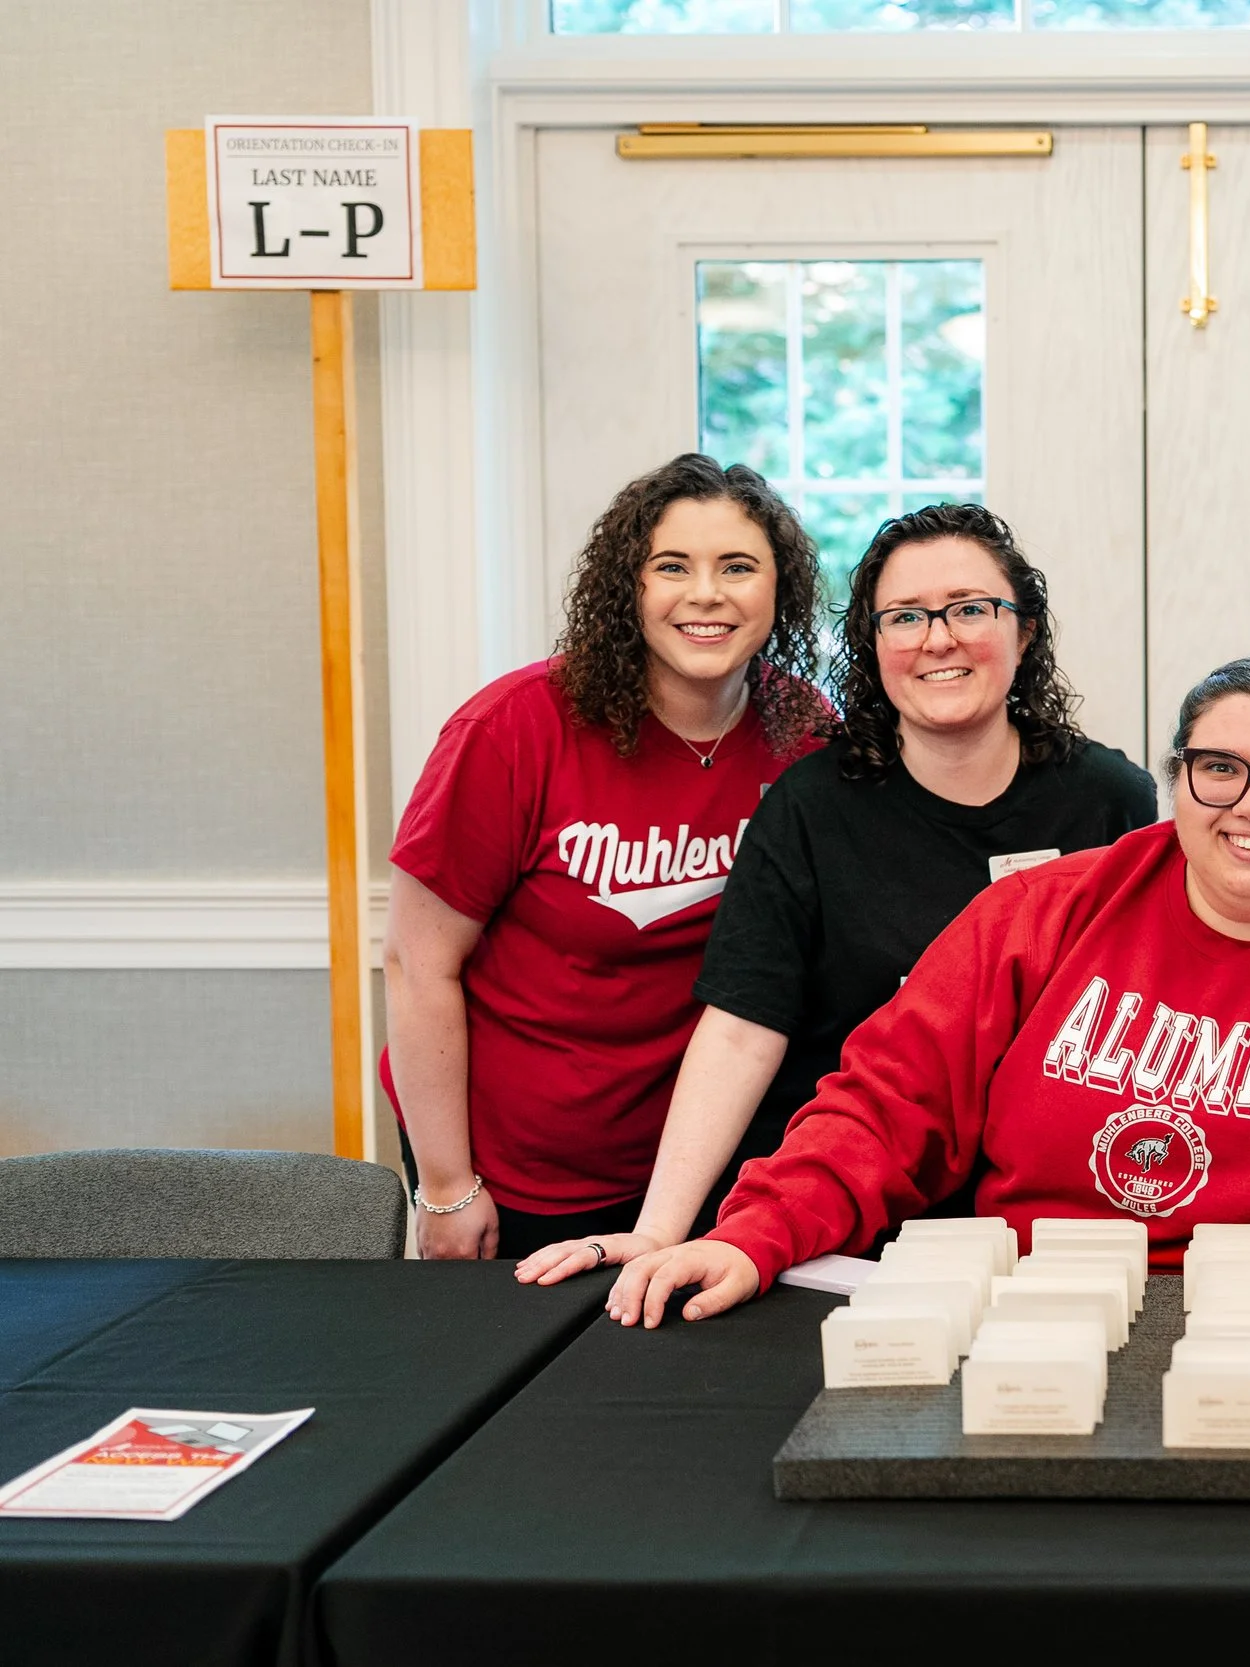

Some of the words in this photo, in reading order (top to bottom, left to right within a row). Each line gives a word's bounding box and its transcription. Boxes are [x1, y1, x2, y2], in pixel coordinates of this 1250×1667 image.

[226, 138, 325, 152] ORIENTATION
[327, 138, 399, 152] CHECK-IN
[251, 168, 306, 187] LAST
[312, 168, 377, 188] NAME
[1097, 1109, 1172, 1153] MUHLENBERG
[1173, 1115, 1206, 1171] COLLEGE
[1117, 1172, 1174, 1188] ESTABLISHED
[1132, 1183, 1155, 1196] 1848
[1121, 1197, 1157, 1213] MULES
